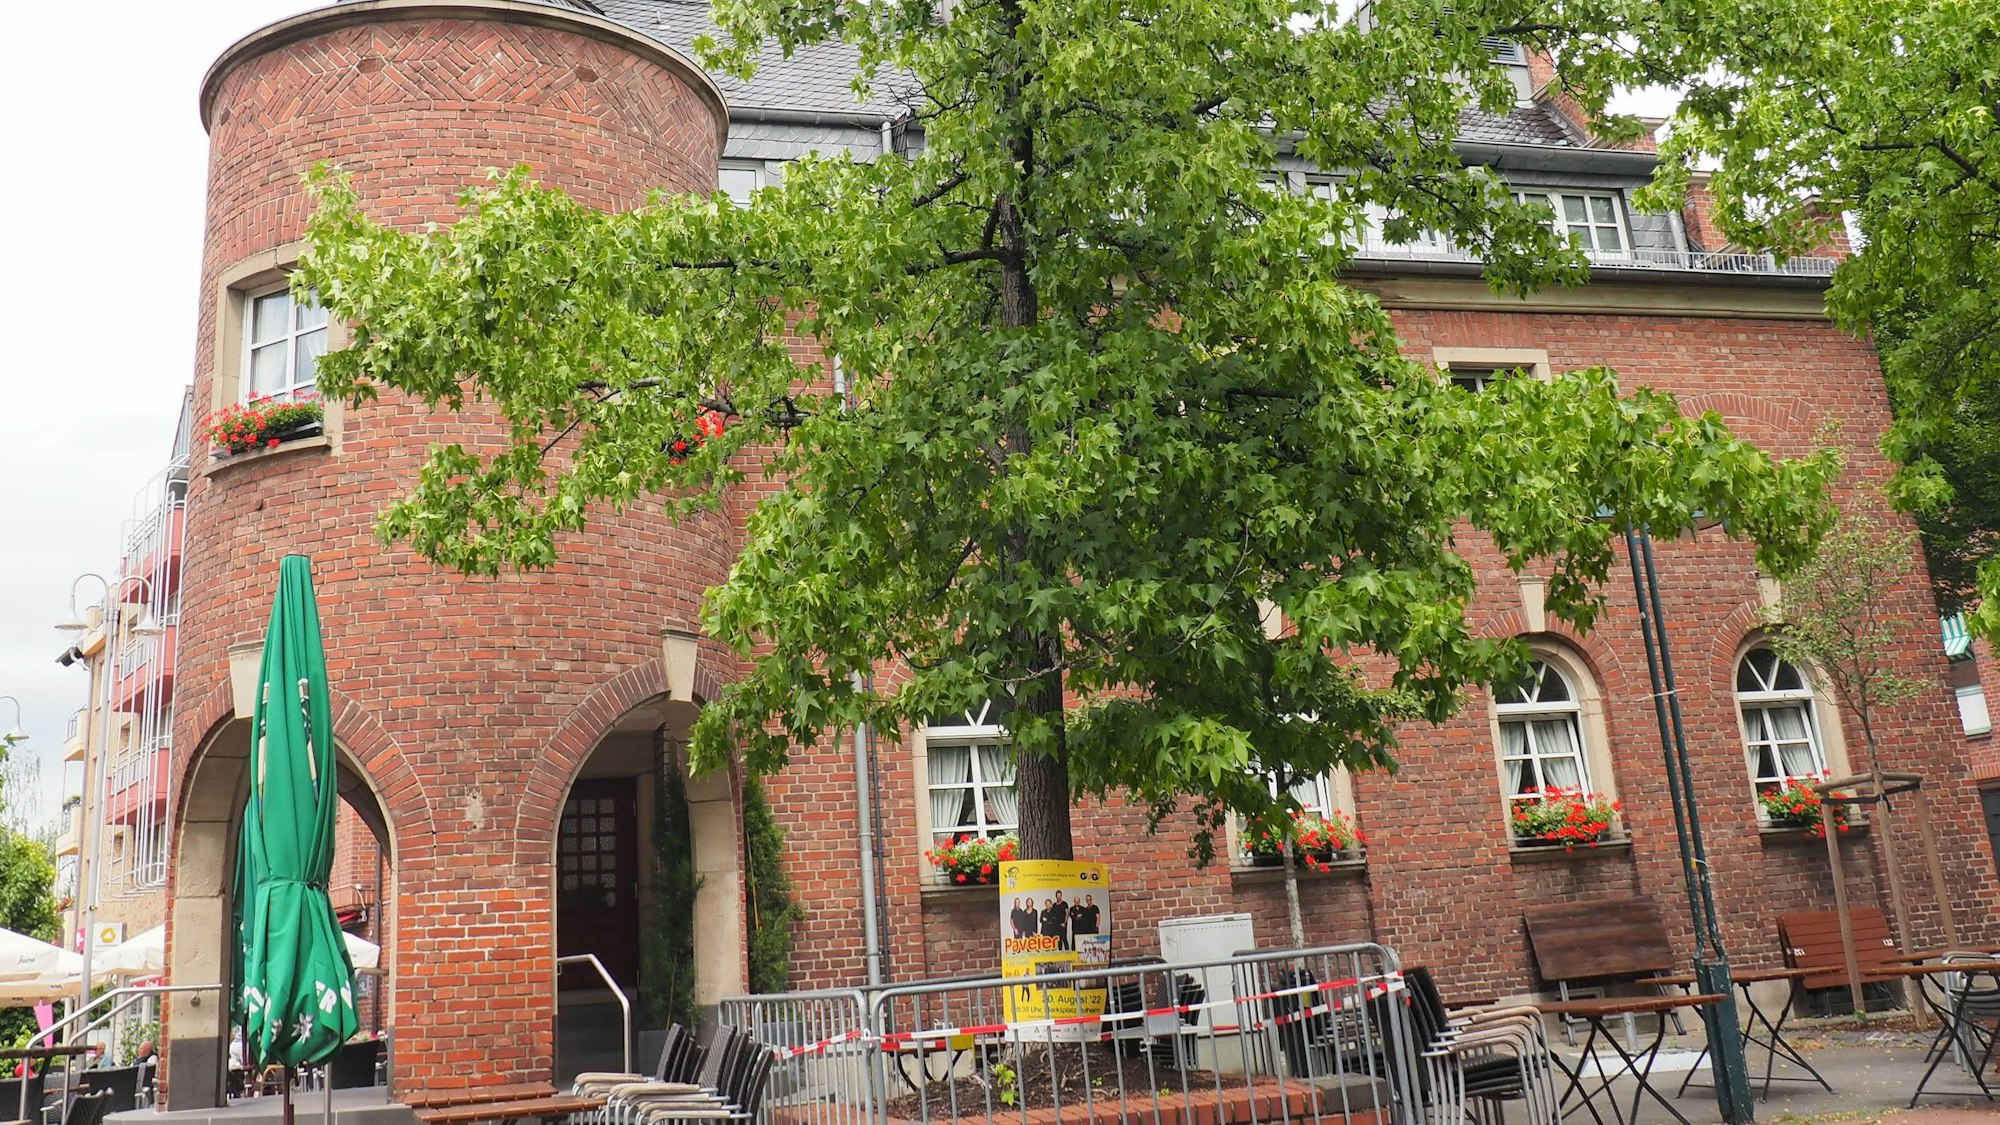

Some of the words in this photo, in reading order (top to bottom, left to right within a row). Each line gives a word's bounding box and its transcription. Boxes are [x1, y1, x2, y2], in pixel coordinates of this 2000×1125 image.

[1080, 872, 1099, 881] GG
[1004, 934, 1060, 953] Paveier
[1089, 995, 1102, 1004] '22
